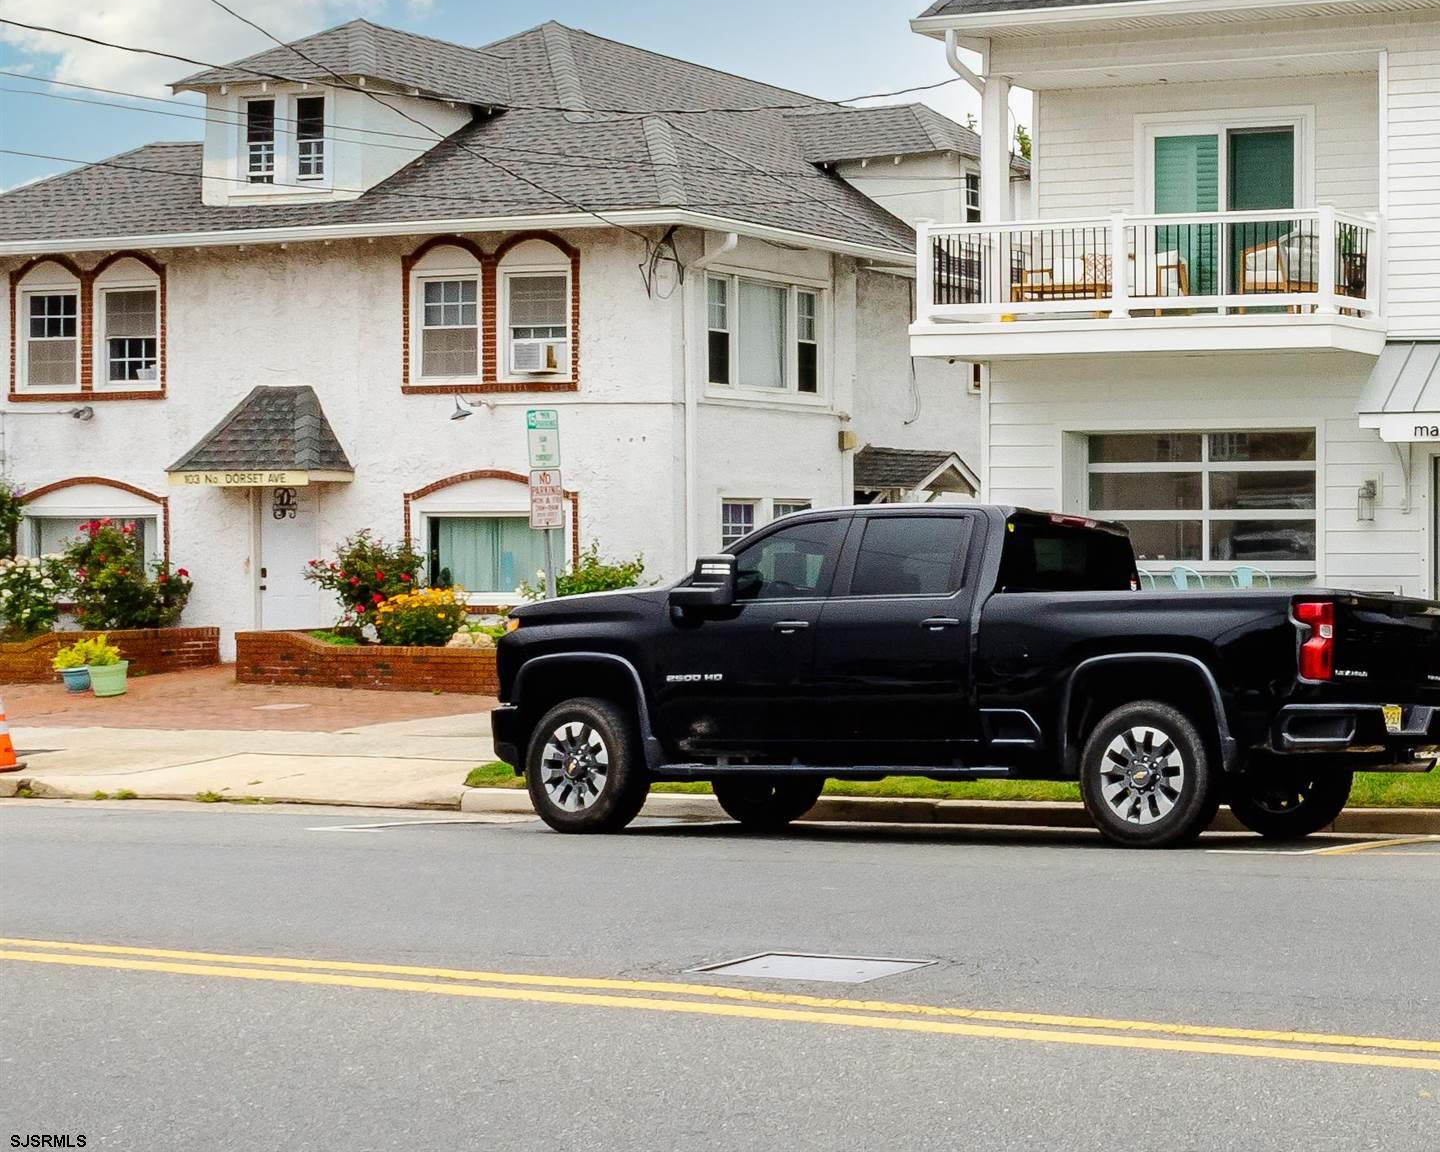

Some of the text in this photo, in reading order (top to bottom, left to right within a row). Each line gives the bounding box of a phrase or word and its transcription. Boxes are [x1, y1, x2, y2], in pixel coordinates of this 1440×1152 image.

[225, 473, 264, 484] DORSET
[539, 473, 551, 484] NO
[666, 673, 723, 682] 2500 HD
